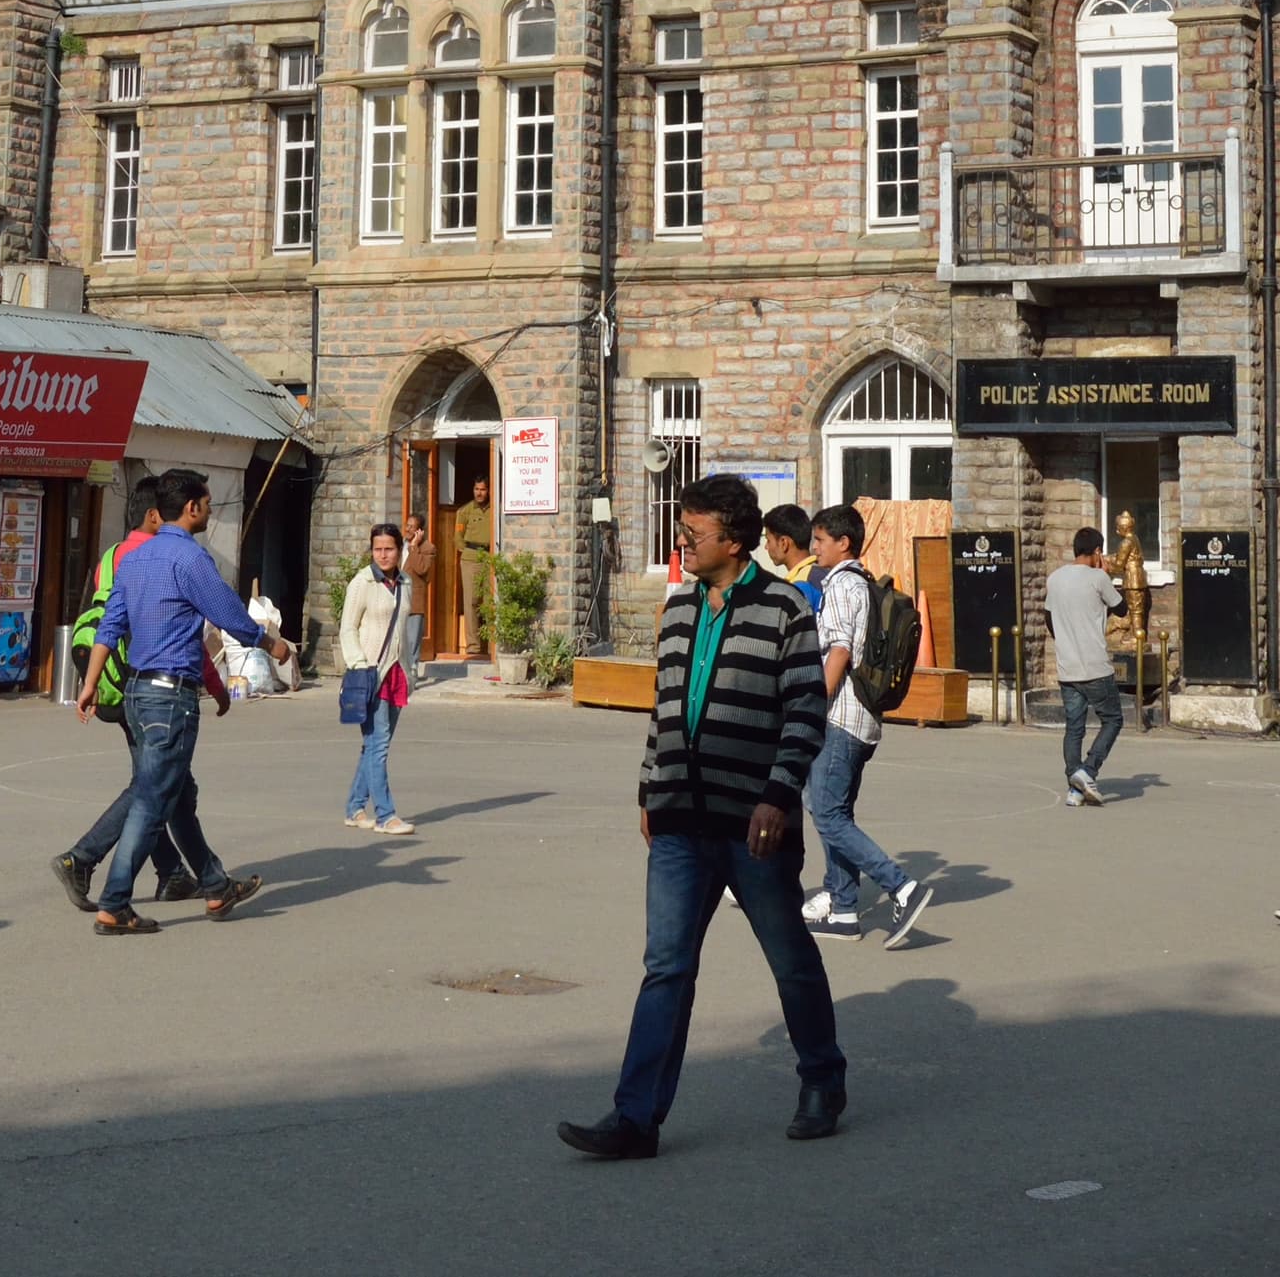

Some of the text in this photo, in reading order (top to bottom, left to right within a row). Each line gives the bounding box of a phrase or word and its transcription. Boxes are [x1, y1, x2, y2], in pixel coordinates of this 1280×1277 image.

[980, 382, 1210, 405] POLICE ASSISTANCE ROOM
[512, 455, 549, 464] ATTENTION
[531, 467, 542, 475] ARE
[510, 499, 550, 507] SURVEILLANCE
